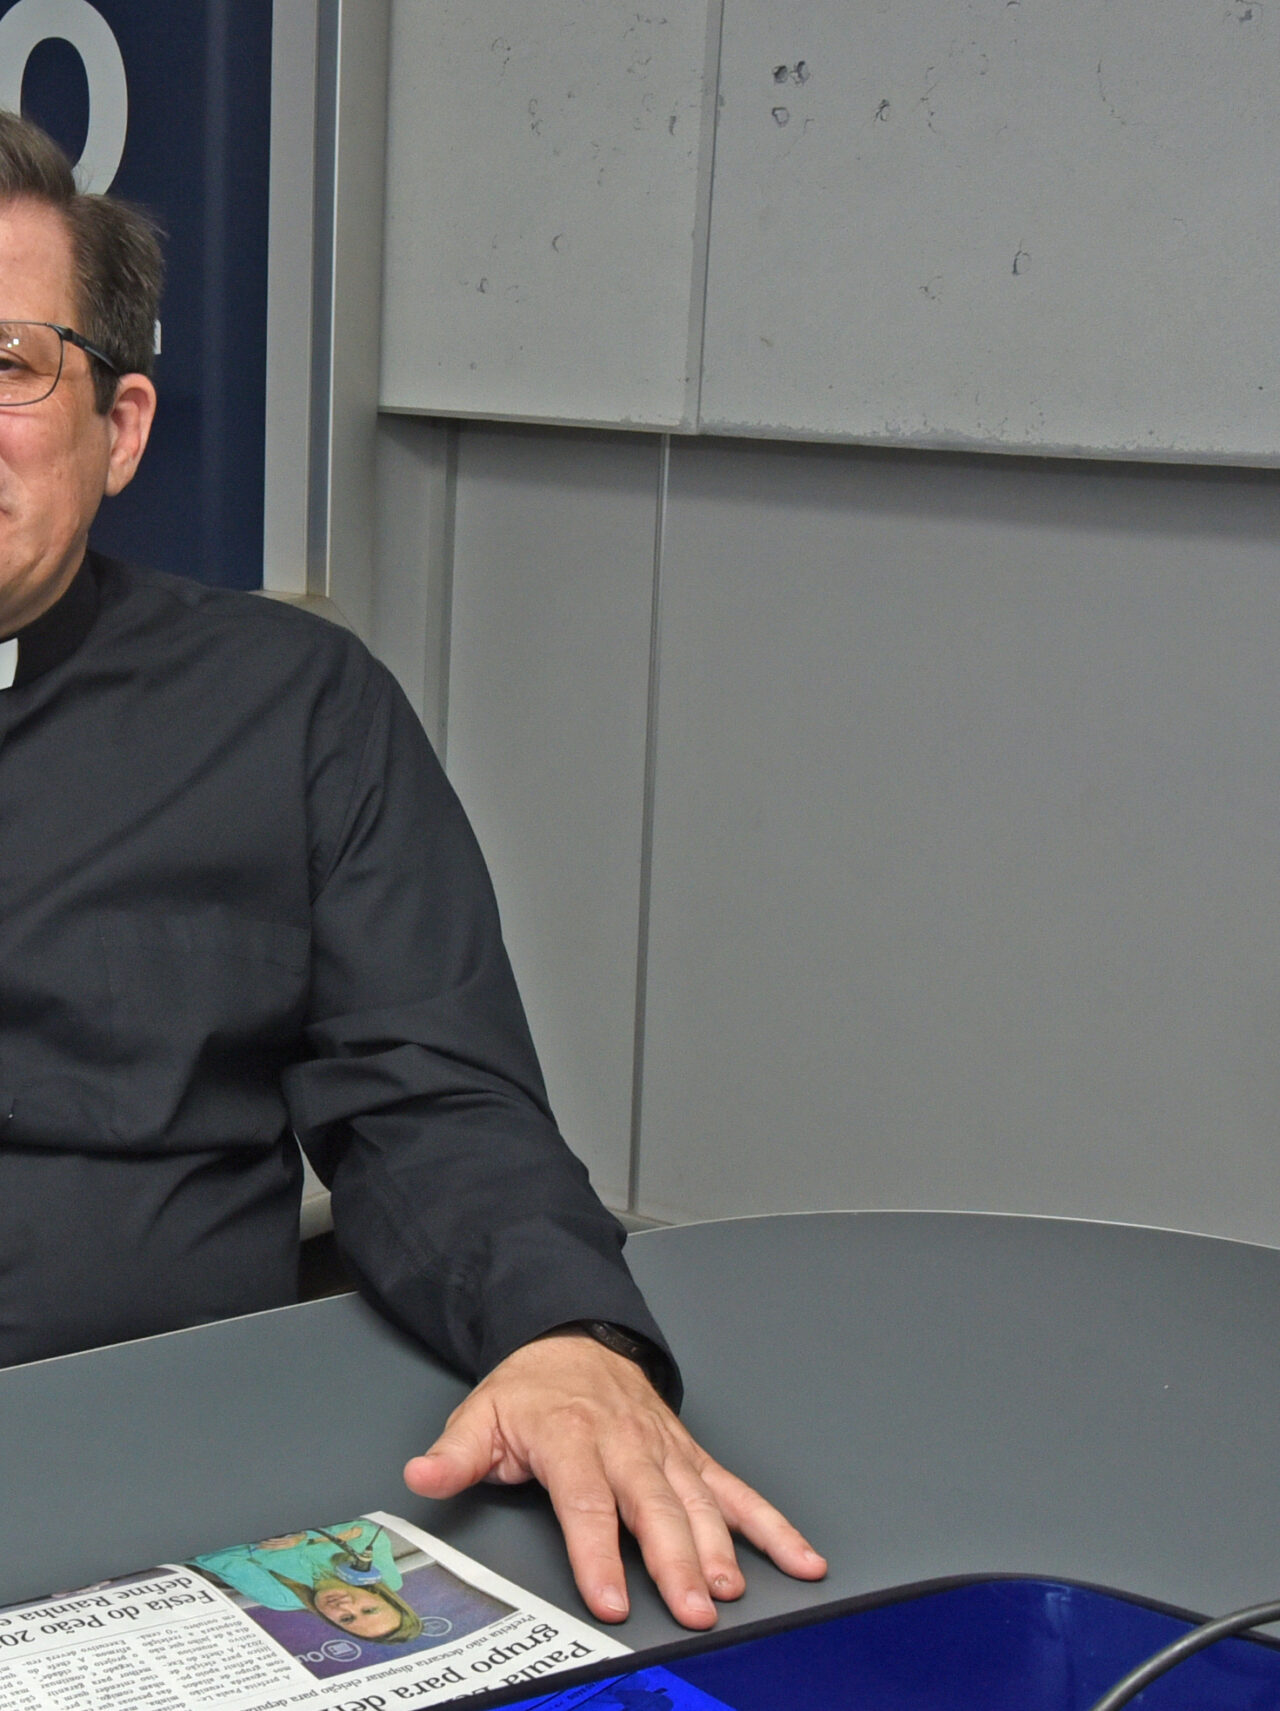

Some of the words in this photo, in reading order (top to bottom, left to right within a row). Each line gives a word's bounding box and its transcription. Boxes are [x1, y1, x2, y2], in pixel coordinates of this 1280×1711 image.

[116, 1577, 192, 1599] define
[17, 1595, 113, 1620] Rainha
[144, 1589, 215, 1610] Festa
[107, 1605, 139, 1620] do
[40, 1614, 105, 1634] Peão
[490, 1614, 537, 1638] Prefeita
[466, 1636, 488, 1650] não
[470, 1623, 559, 1674] grupo
[415, 1647, 464, 1667] descarta
[499, 1640, 597, 1687] Paula
[365, 1661, 414, 1683] disputar
[320, 1678, 362, 1695] eleição
[390, 1667, 468, 1699] para
[289, 1689, 319, 1703] para
